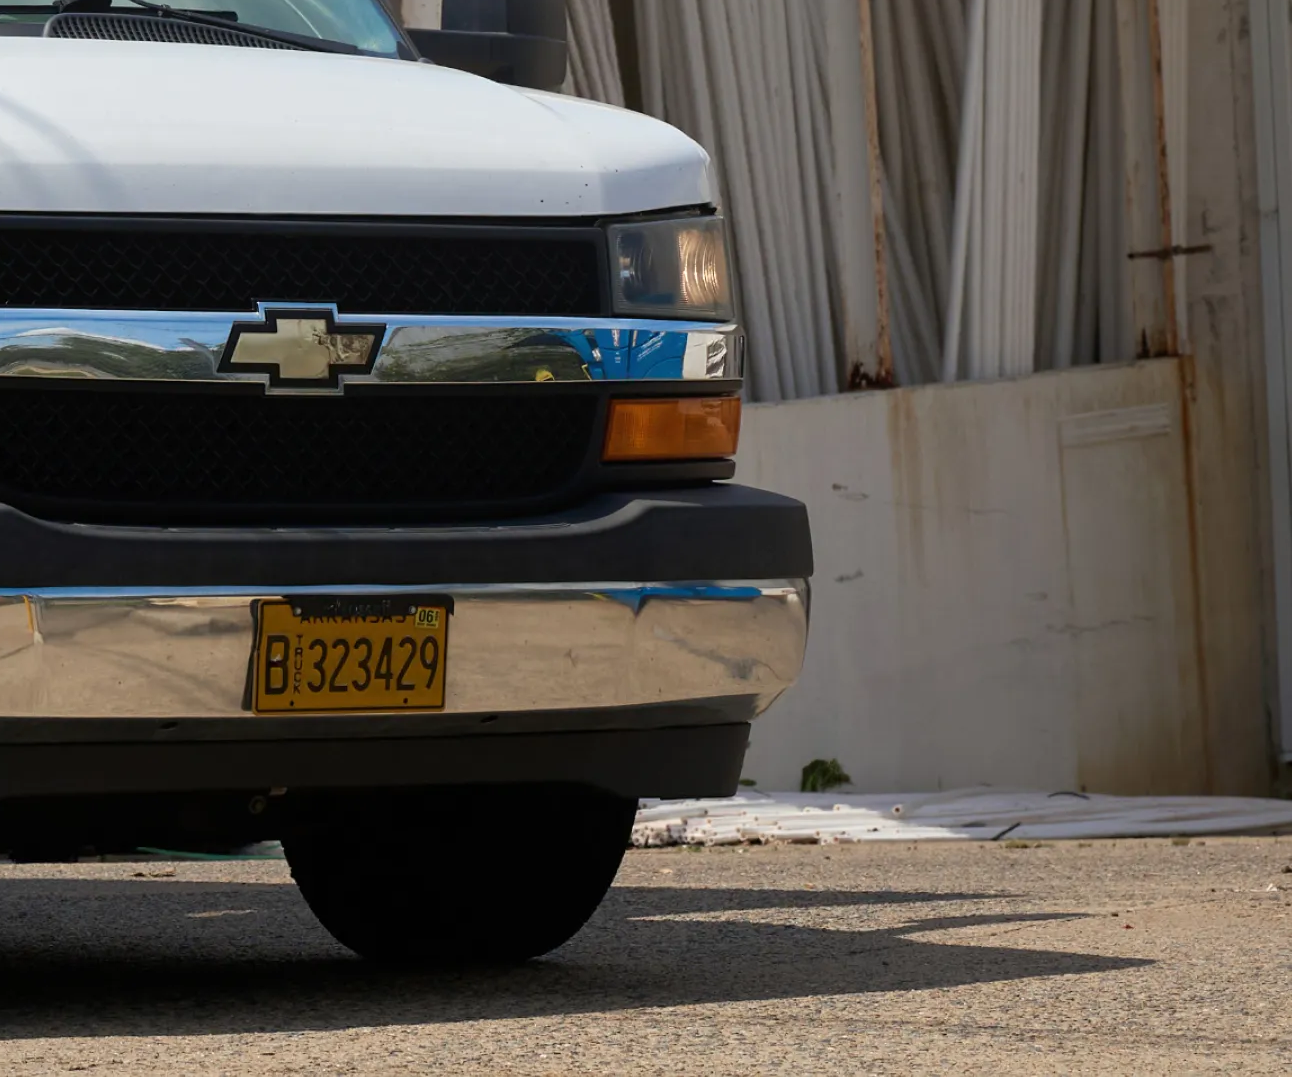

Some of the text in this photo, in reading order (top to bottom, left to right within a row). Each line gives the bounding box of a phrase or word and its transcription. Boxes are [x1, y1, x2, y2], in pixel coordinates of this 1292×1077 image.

[418, 609, 434, 623] 06
[265, 634, 440, 696] B TRUCK 323429
